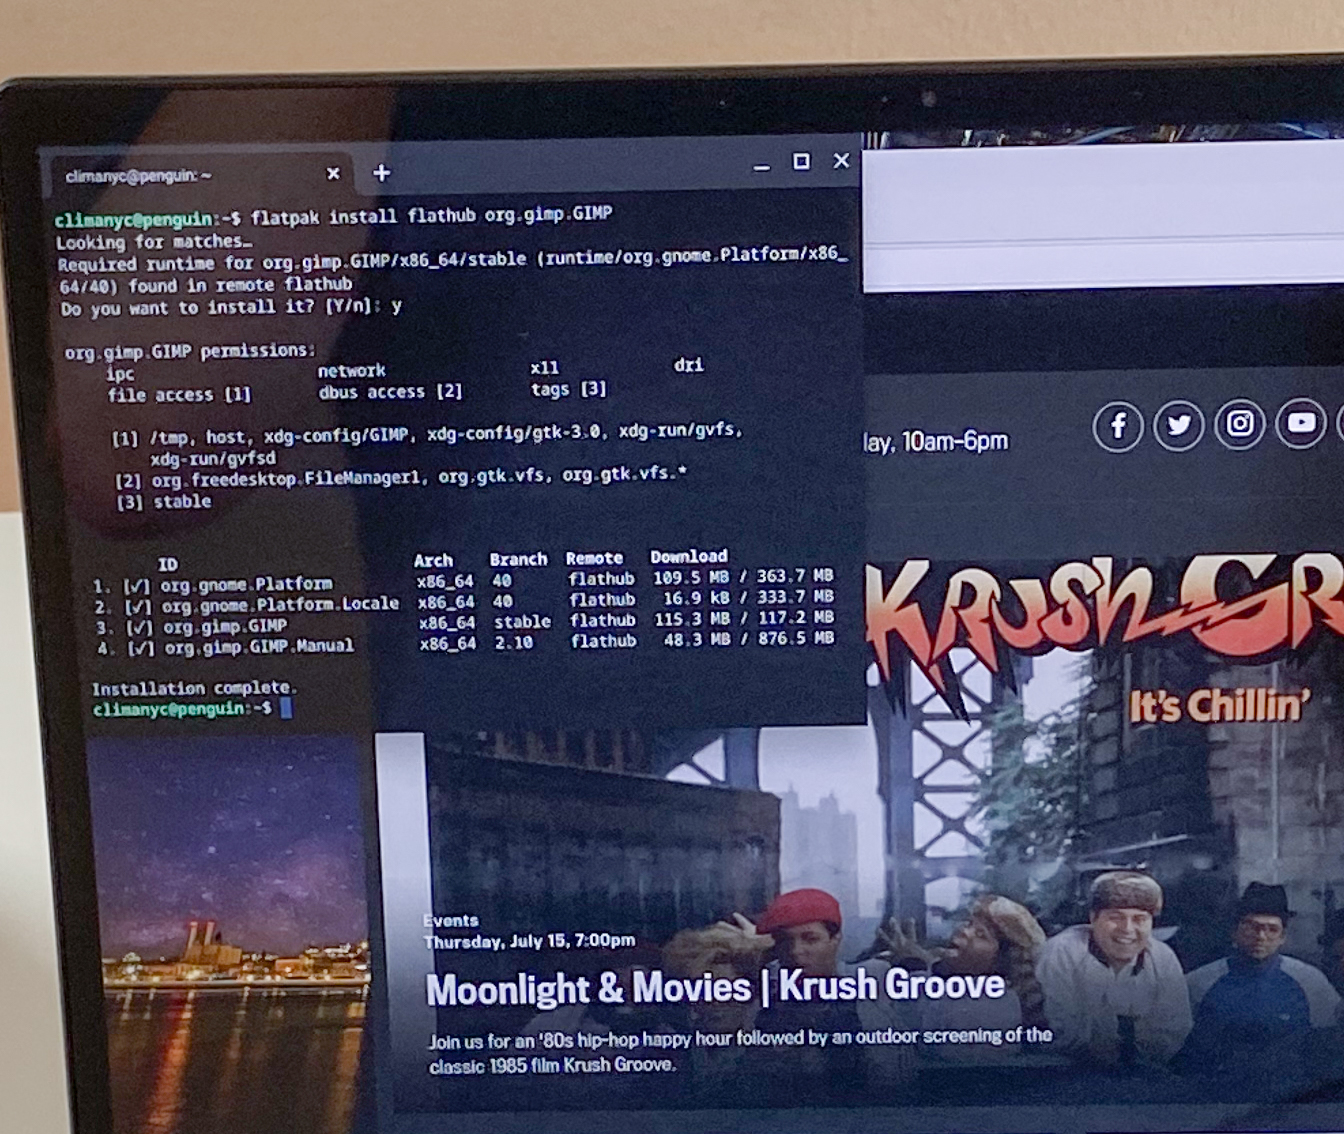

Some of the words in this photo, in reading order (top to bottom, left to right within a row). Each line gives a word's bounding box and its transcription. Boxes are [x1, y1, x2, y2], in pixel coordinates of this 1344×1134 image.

[252, 210, 319, 228] flatpak
[330, 208, 397, 224] install
[408, 208, 476, 223] flathub
[485, 205, 612, 225] org.gimp.GIMP
[57, 235, 125, 253] Looking
[135, 234, 163, 249] for
[59, 256, 137, 274] Required
[147, 256, 214, 271] runtime
[226, 255, 253, 269] for
[60, 280, 116, 295] 64/40)
[129, 279, 177, 293] found
[188, 278, 206, 292] in
[217, 279, 274, 292] remote
[285, 276, 352, 291] flathub
[62, 302, 81, 316] Do
[92, 305, 120, 319] you
[130, 302, 168, 315] want
[179, 302, 198, 314] to
[209, 299, 275, 314] install
[287, 299, 314, 313] it?
[66, 344, 191, 363] org.gimp.GIMP
[201, 343, 314, 361] permissions:
[107, 366, 134, 383] ipc
[318, 363, 386, 378] network
[531, 361, 558, 374] x11
[675, 358, 704, 372] dri
[109, 388, 145, 402] file
[156, 390, 213, 402] access
[319, 385, 358, 399] dbus
[368, 387, 425, 399] access
[438, 383, 462, 400] [2]
[532, 384, 569, 400] tags
[151, 431, 194, 447] /tmp,
[207, 430, 252, 445] host,
[265, 427, 415, 446] xdg-config/GIMP,
[428, 424, 607, 444] xdg-config/gtk-3.0,
[620, 421, 741, 441] xdg-run/gvfs,
[151, 450, 276, 470] xdg-run/gvfsd
[117, 474, 140, 490] [2]
[439, 467, 551, 486] org.gtk.vfs,
[155, 494, 211, 508] stable
[159, 558, 178, 571] ID
[414, 553, 453, 567] Arch
[491, 552, 547, 566] Branch
[567, 552, 623, 565] Remote
[651, 549, 727, 563] Download
[161, 576, 332, 596] org.gnome.Platform
[417, 574, 473, 590] x86_64
[493, 574, 511, 587] 40
[570, 572, 634, 586] flathub
[758, 569, 805, 583] 363.7
[163, 596, 399, 616] org.gnome.Platform.Locale
[419, 595, 474, 611] x86_64
[493, 595, 513, 608] 40
[570, 592, 635, 607] flathub
[665, 591, 701, 605] 16.9
[758, 590, 805, 604] 333.7
[164, 619, 287, 637] org.gimp.GIMP
[420, 616, 475, 632] x86_64
[495, 614, 551, 629] stable
[571, 613, 636, 627] flathub
[656, 612, 701, 626] 115.3
[760, 610, 805, 624] 117.2
[166, 638, 354, 657] org.gimp.GIMP.Manual
[421, 636, 476, 652] x86_64
[496, 636, 533, 649] 2.10
[572, 634, 636, 648] flathub
[665, 633, 702, 646] 48.3
[759, 631, 805, 645] 876.5
[93, 681, 205, 696] Installation
[215, 680, 296, 697] complete.
[423, 914, 479, 928] Events
[423, 932, 505, 954] Thursday,
[510, 934, 543, 950] July
[548, 933, 570, 948] 15,
[575, 933, 635, 949] 7:00pm
[427, 972, 590, 1010] Moonlight
[599, 972, 624, 1002] &
[634, 971, 751, 1002] Movies
[780, 967, 877, 1000] Krush
[886, 968, 1005, 999] Groove
[428, 1034, 461, 1050] Join
[465, 1038, 483, 1049] us
[488, 1033, 511, 1048] for
[515, 1037, 535, 1048] an
[578, 1032, 640, 1050] hip-hop
[643, 1031, 691, 1048] happy
[696, 1031, 733, 1046] hour
[737, 1030, 804, 1045] followed
[809, 1029, 828, 1046] by
[832, 1033, 852, 1044] an
[856, 1028, 919, 1043] outdoor
[924, 1028, 1002, 1045] screening
[1005, 1026, 1022, 1042] of
[1026, 1027, 1052, 1042] the
[430, 1059, 484, 1074] classic
[491, 1057, 528, 1073] 1985
[531, 1058, 560, 1072] film
[564, 1057, 610, 1072] Krush
[614, 1056, 676, 1071] Groove.
